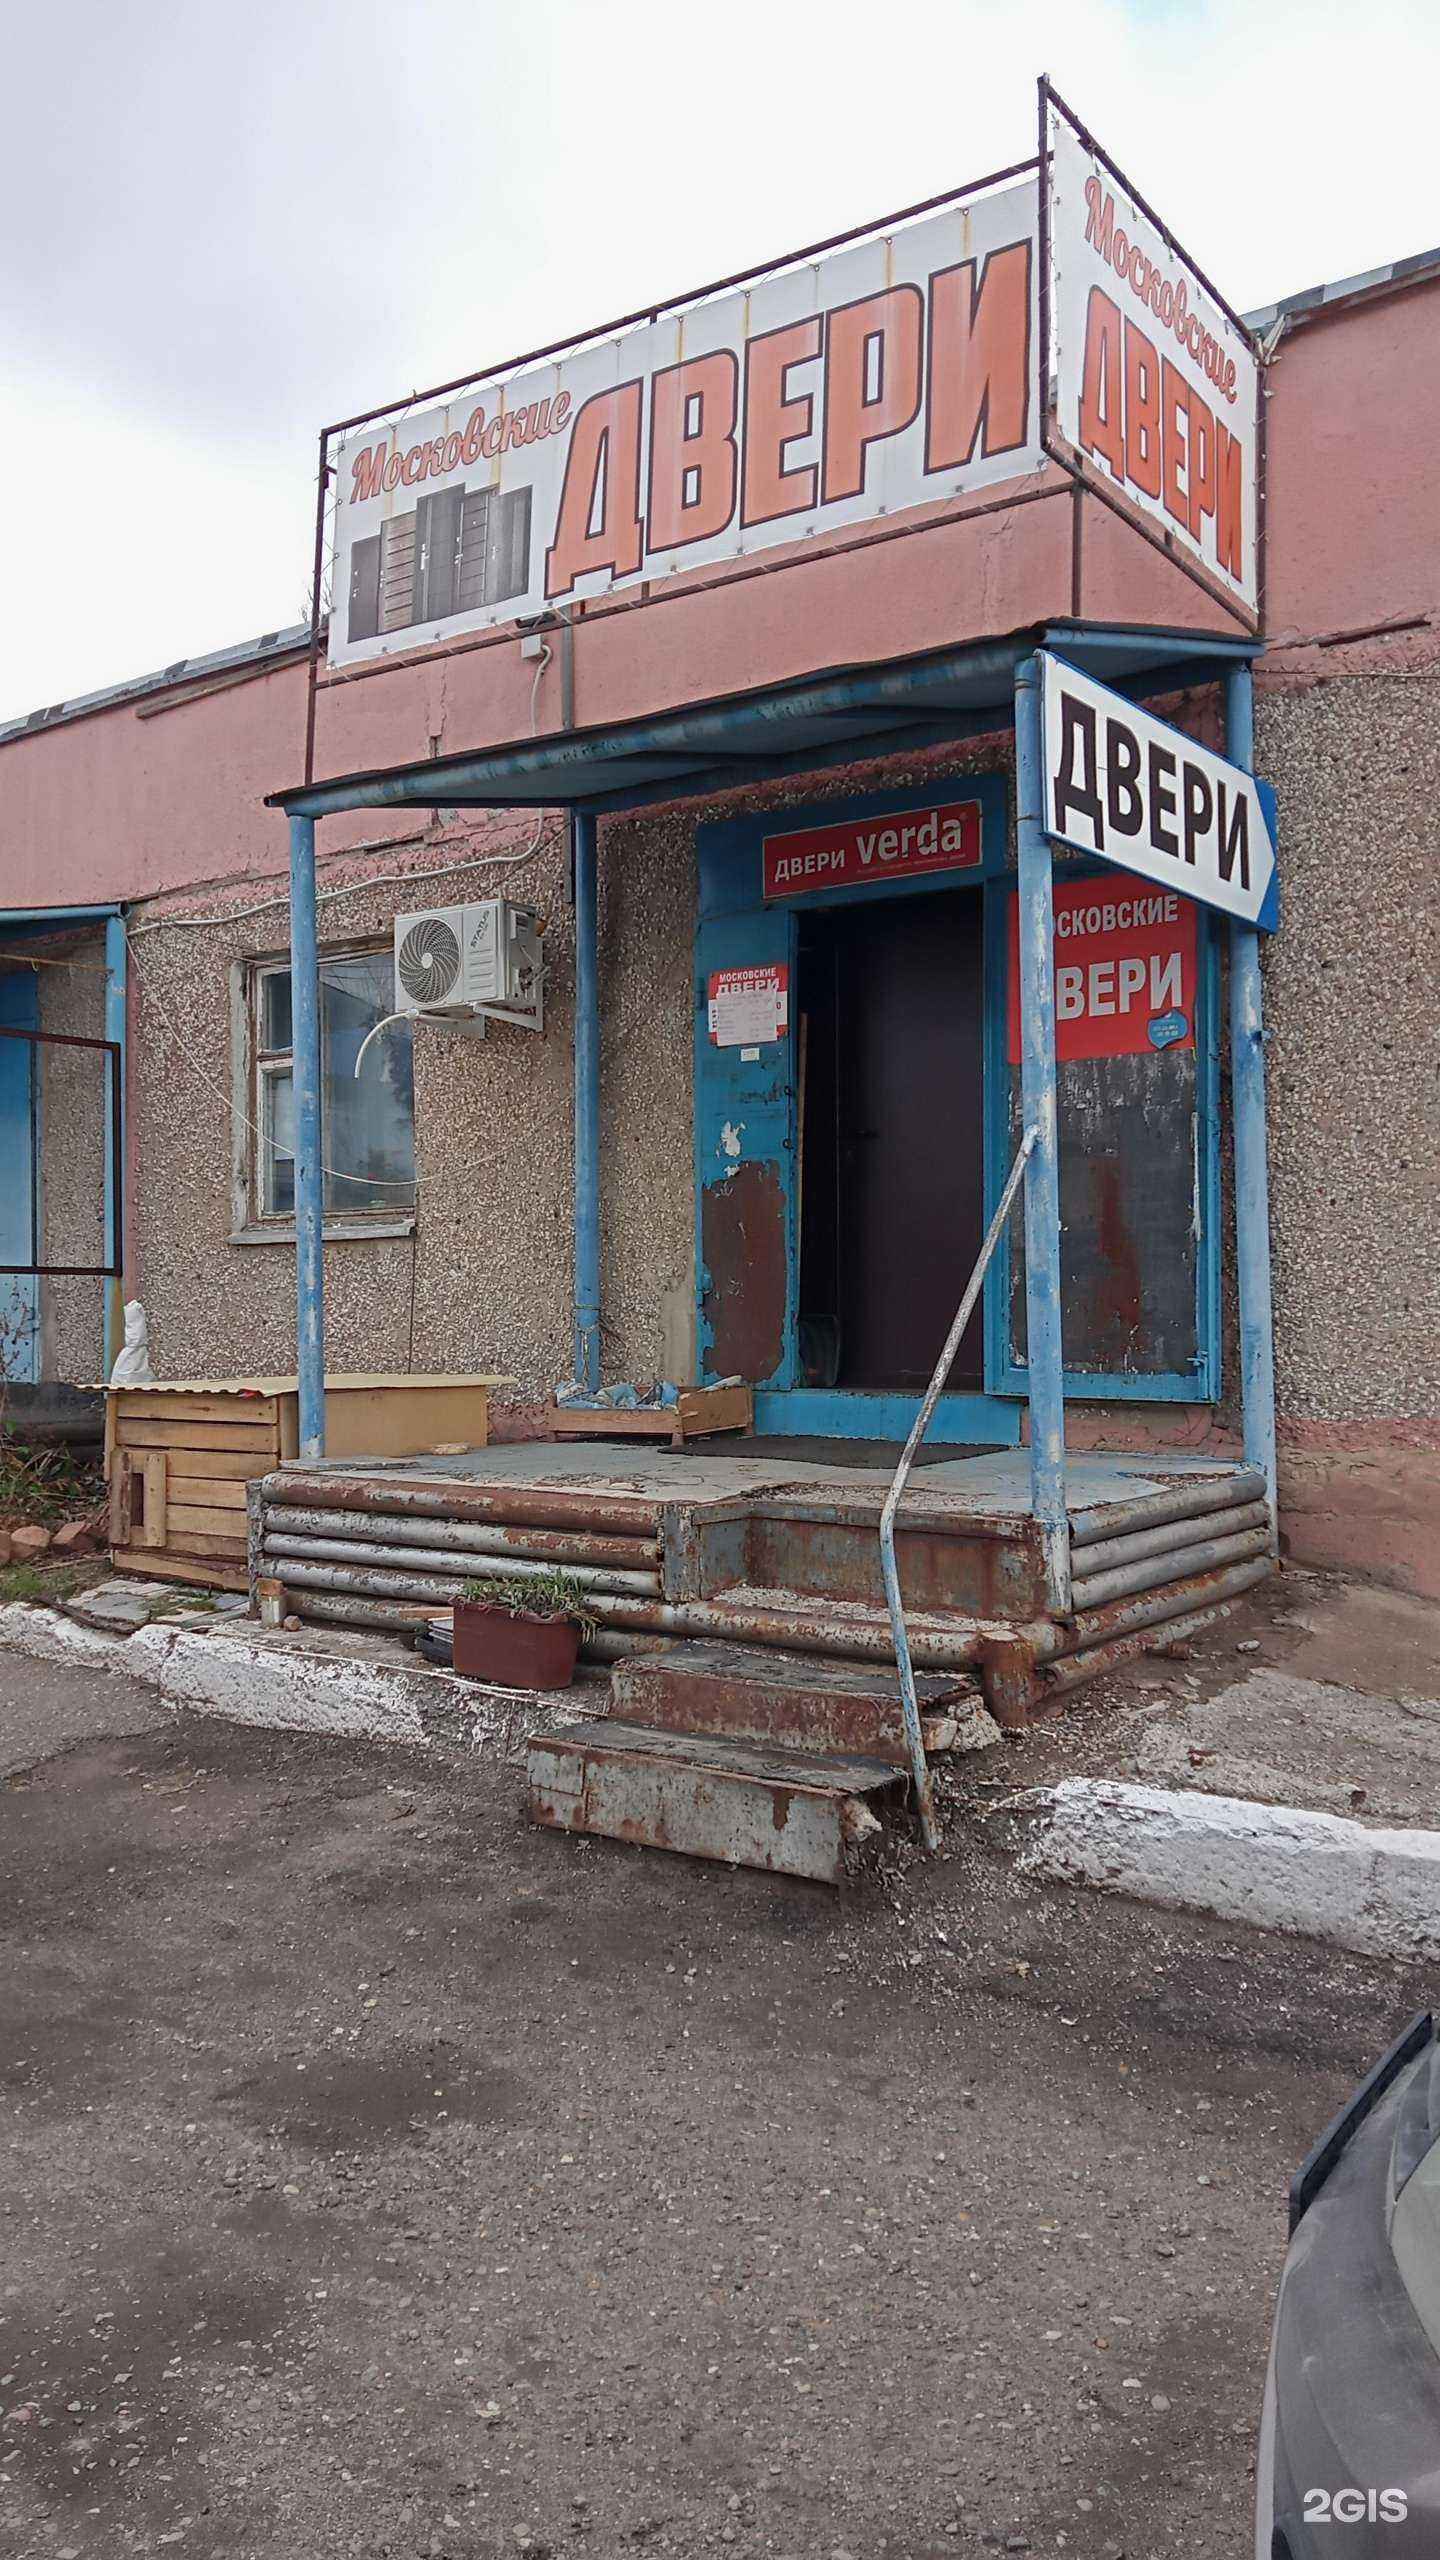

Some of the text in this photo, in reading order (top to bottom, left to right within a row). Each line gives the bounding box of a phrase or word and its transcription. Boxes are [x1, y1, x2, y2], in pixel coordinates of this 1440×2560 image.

[1083, 175, 1238, 405] Московские
[349, 390, 574, 505] Московские
[543, 237, 1034, 601] ДВЕРИ
[1078, 284, 1243, 584] ДВЕРИ
[774, 849, 846, 883] ДВЕРИ
[856, 812, 963, 865] verda
[1053, 689, 1251, 892] ДВЕРИ
[1052, 894, 1179, 938] СКОВСКИЕ
[719, 967, 777, 983] МОСКОВСКИЕ
[1055, 952, 1183, 1020] ВЕРИ
